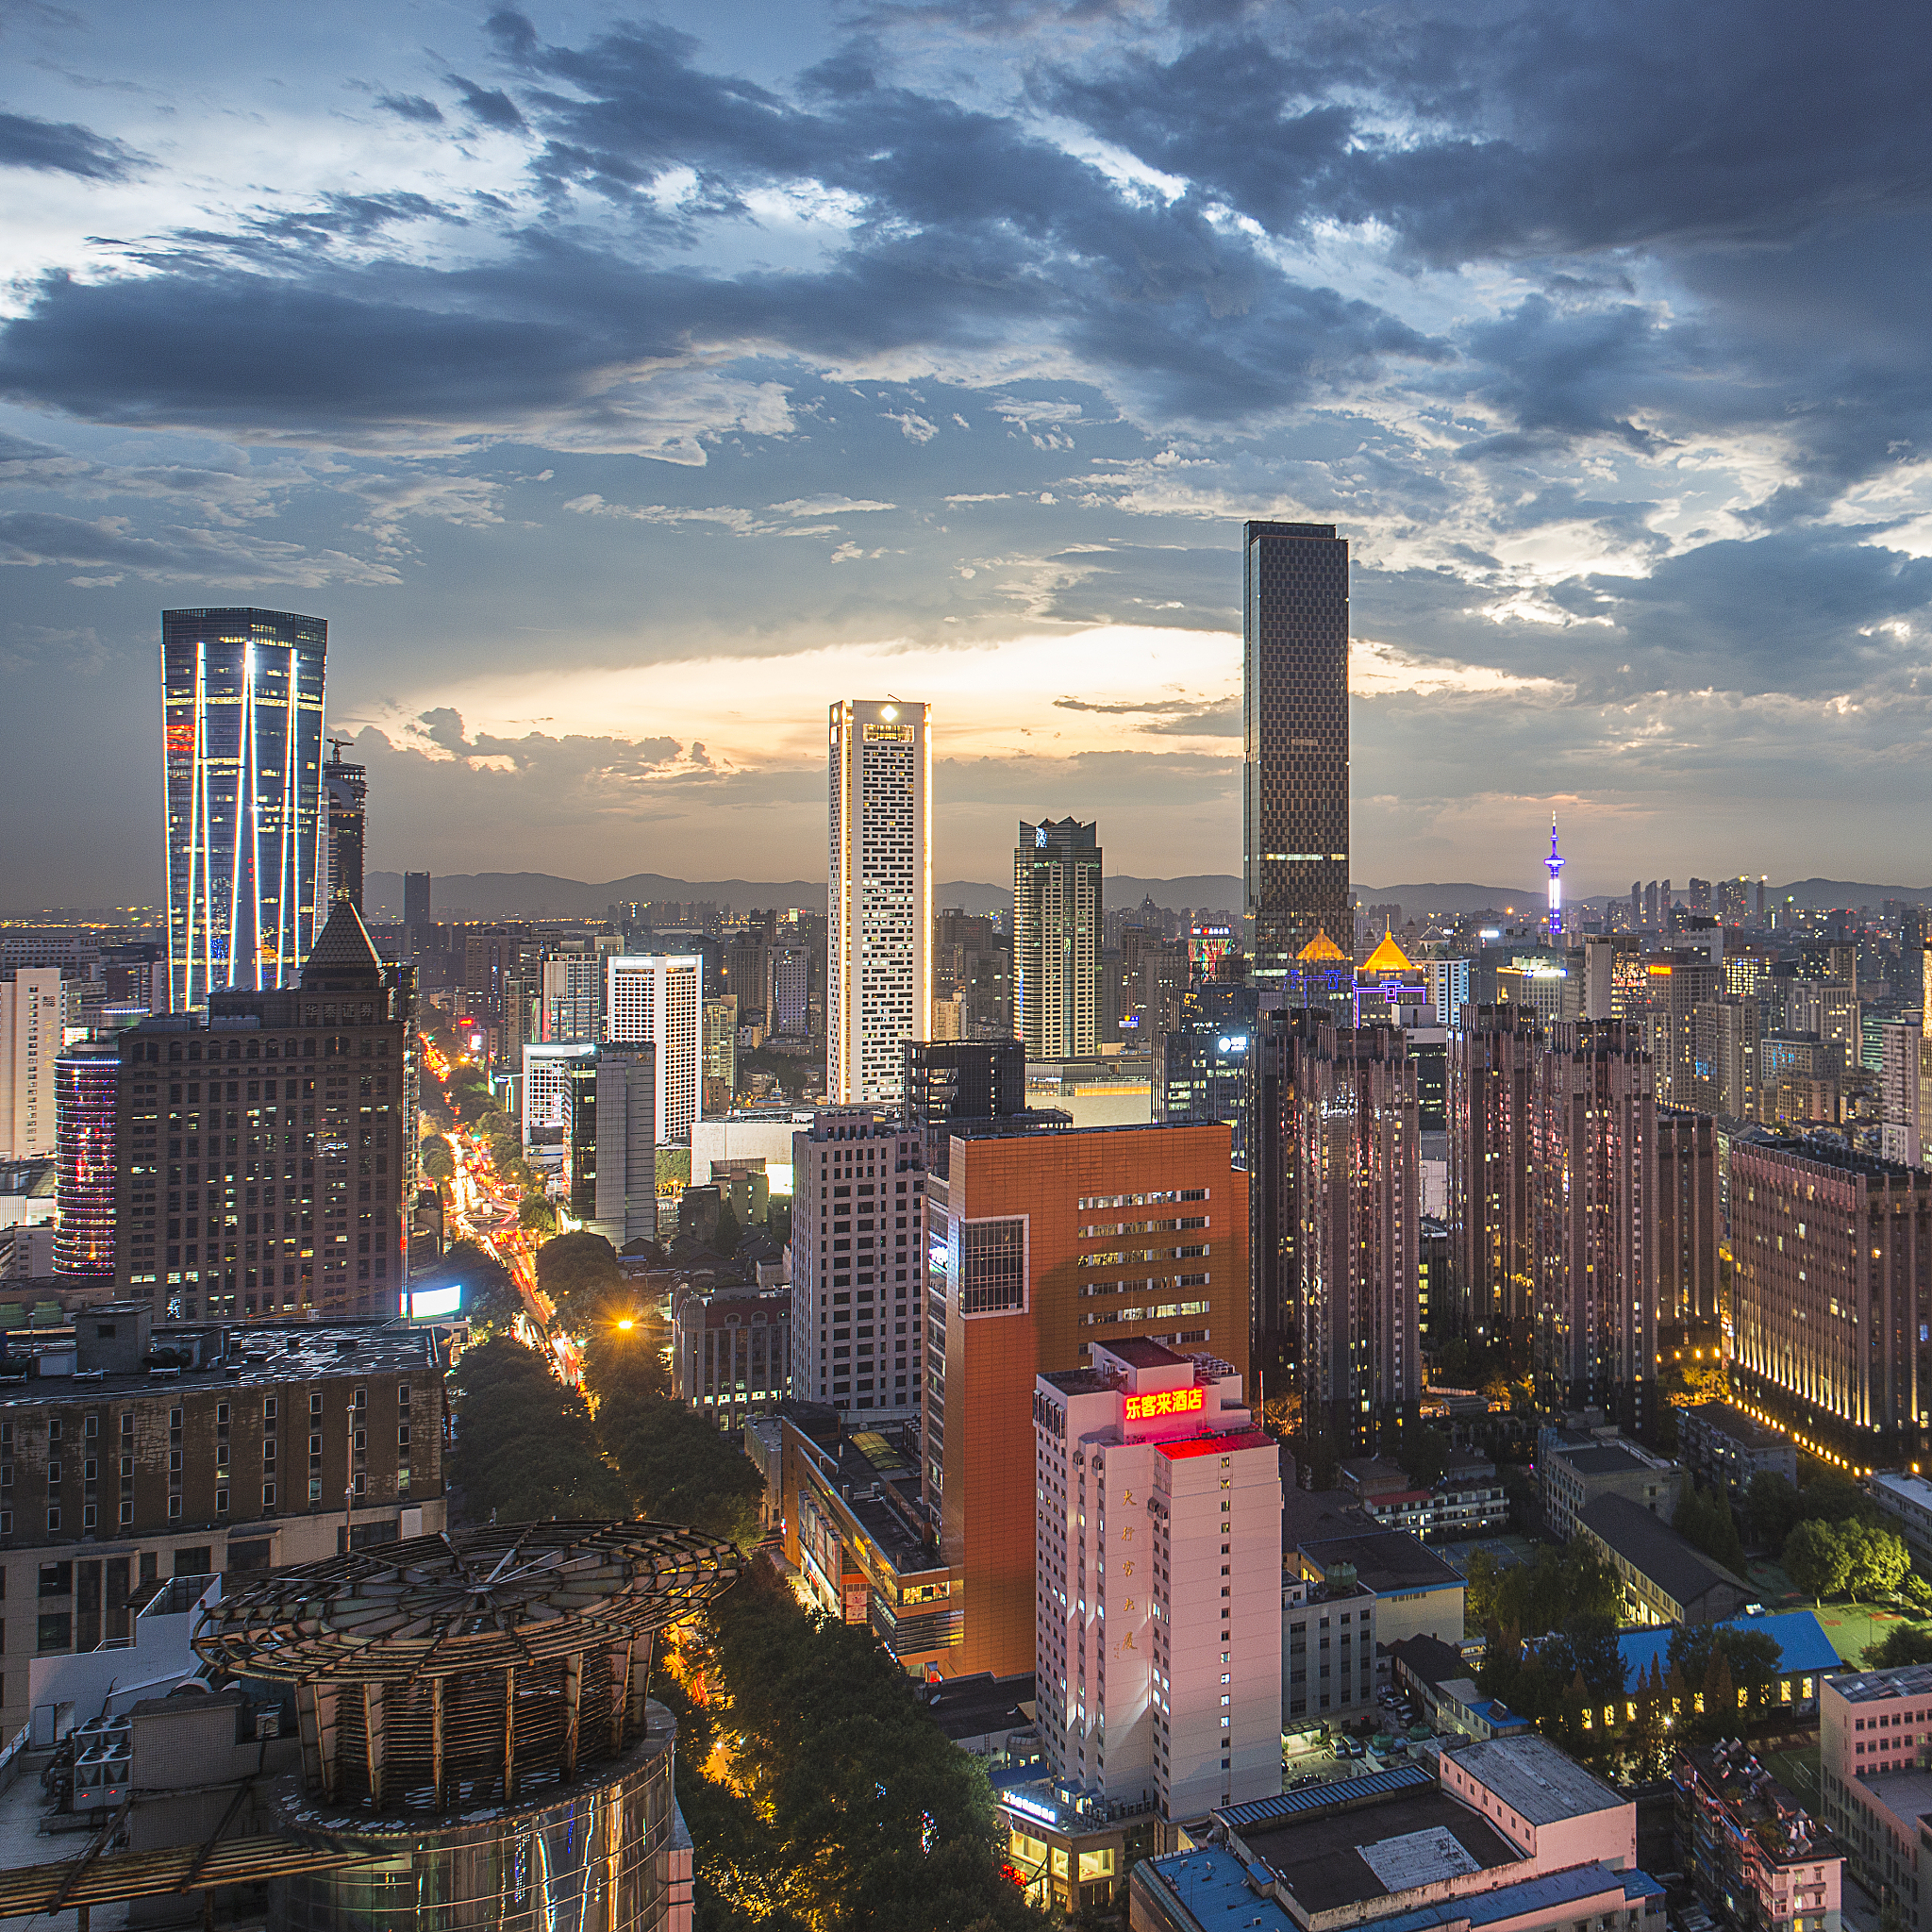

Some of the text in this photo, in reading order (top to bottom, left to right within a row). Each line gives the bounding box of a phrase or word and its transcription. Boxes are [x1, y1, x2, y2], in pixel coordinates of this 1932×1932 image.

[306, 1003, 374, 1019] 华泰证券
[1125, 1389, 1203, 1419] 乐客来酒店
